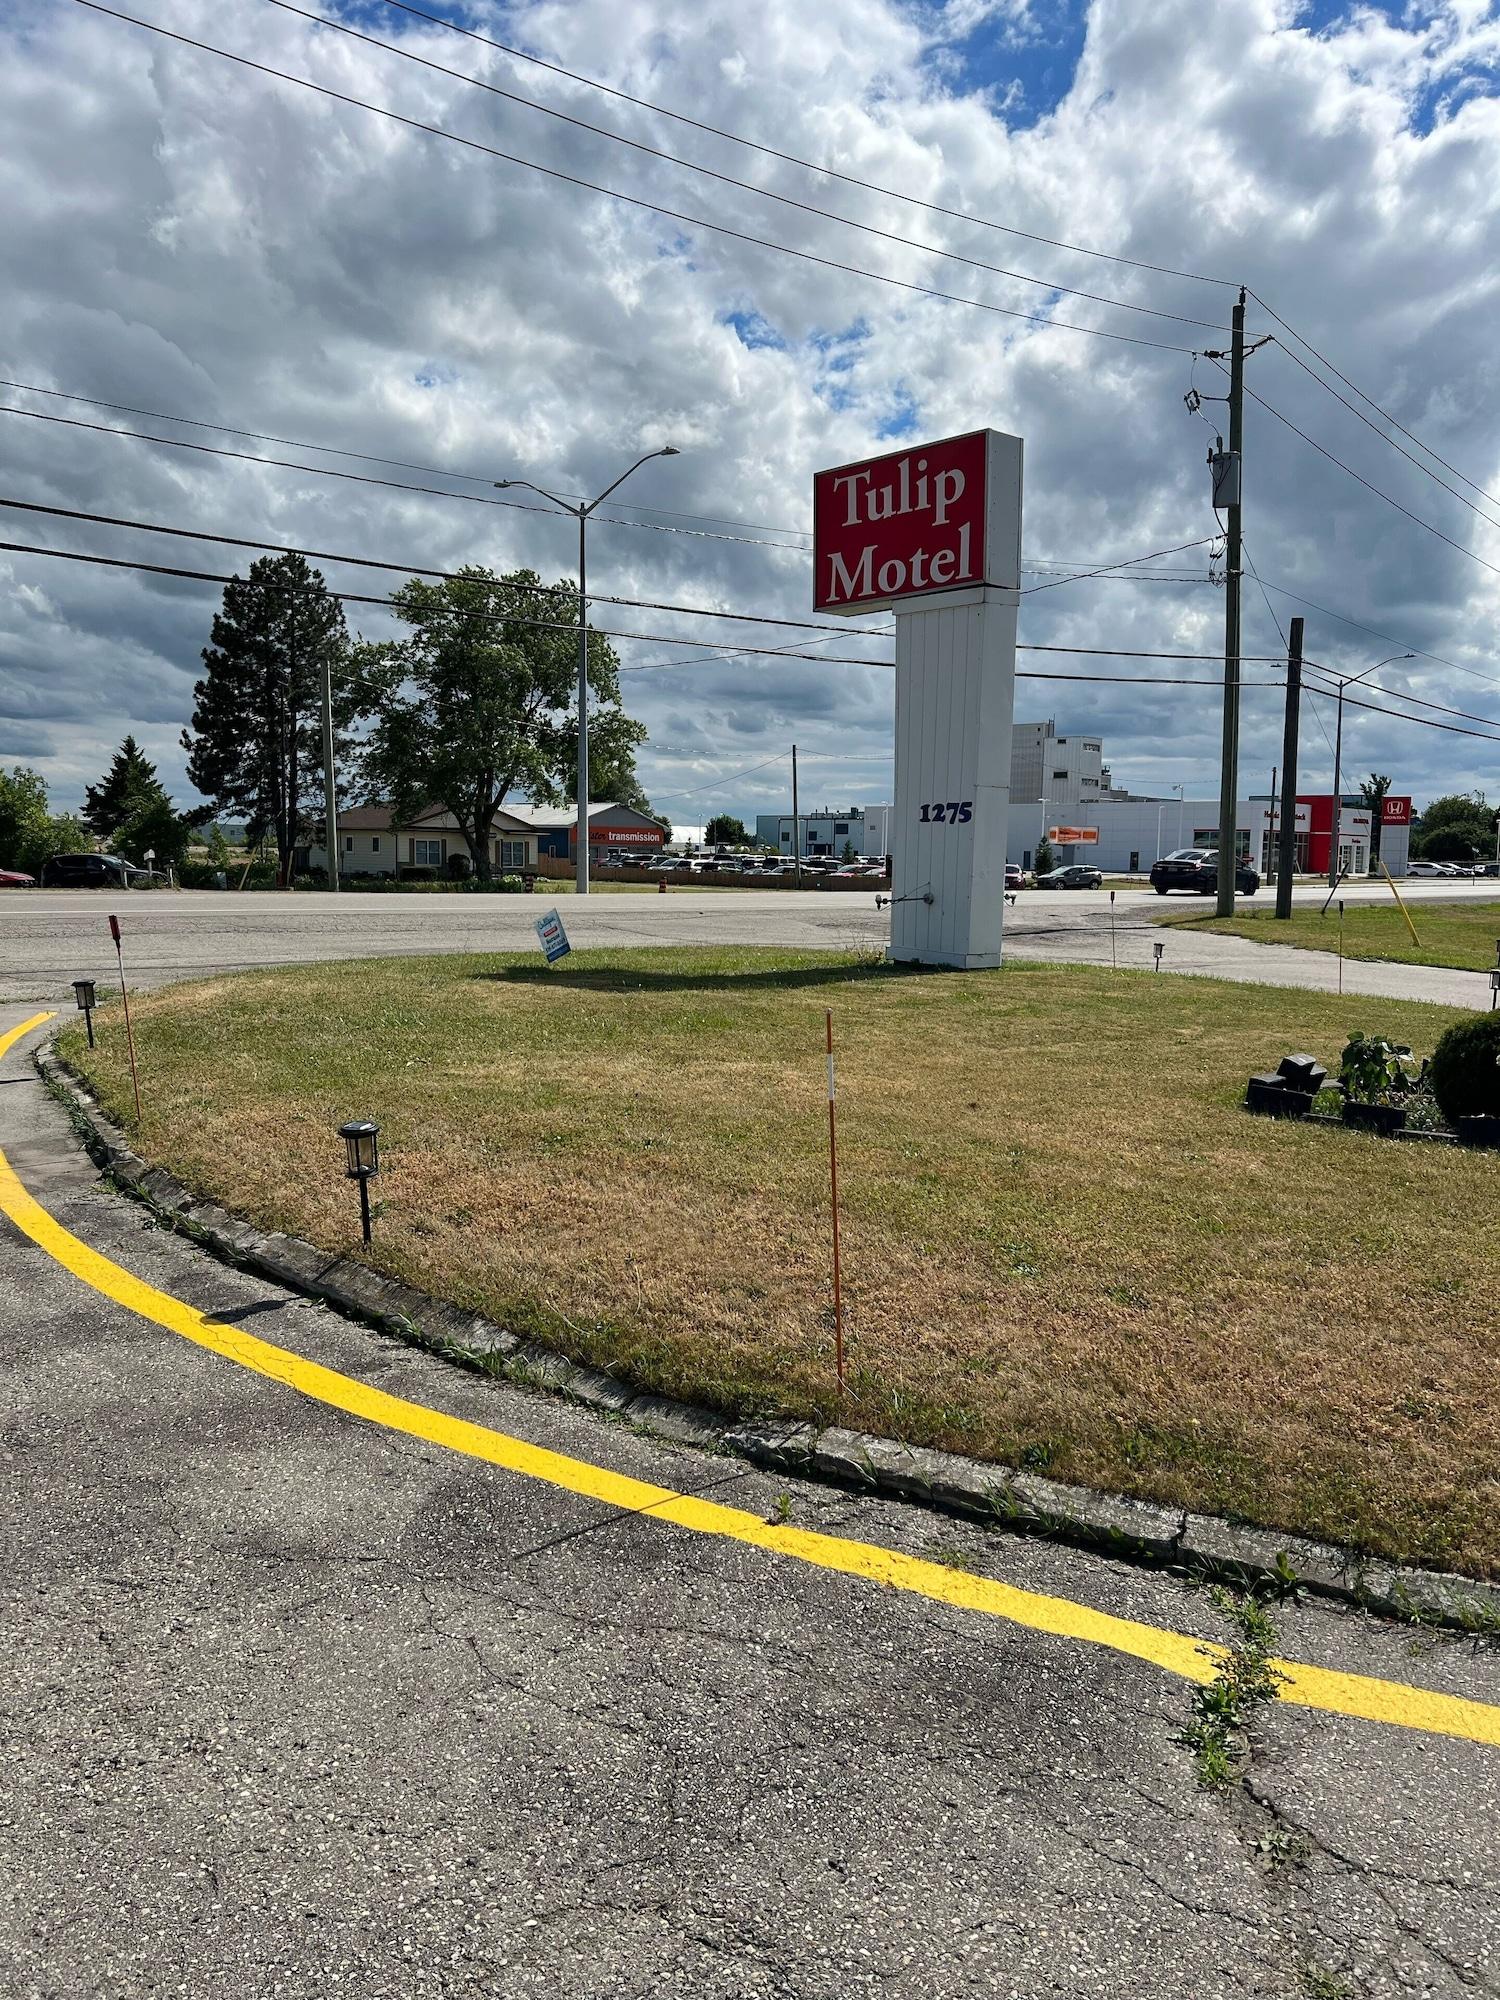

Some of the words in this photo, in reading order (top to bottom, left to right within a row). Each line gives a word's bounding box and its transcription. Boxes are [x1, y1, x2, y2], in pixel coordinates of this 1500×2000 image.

[833, 457, 966, 527] Tulip
[826, 521, 972, 602] Motel
[919, 801, 973, 824] 1275
[608, 831, 660, 842] transmission
